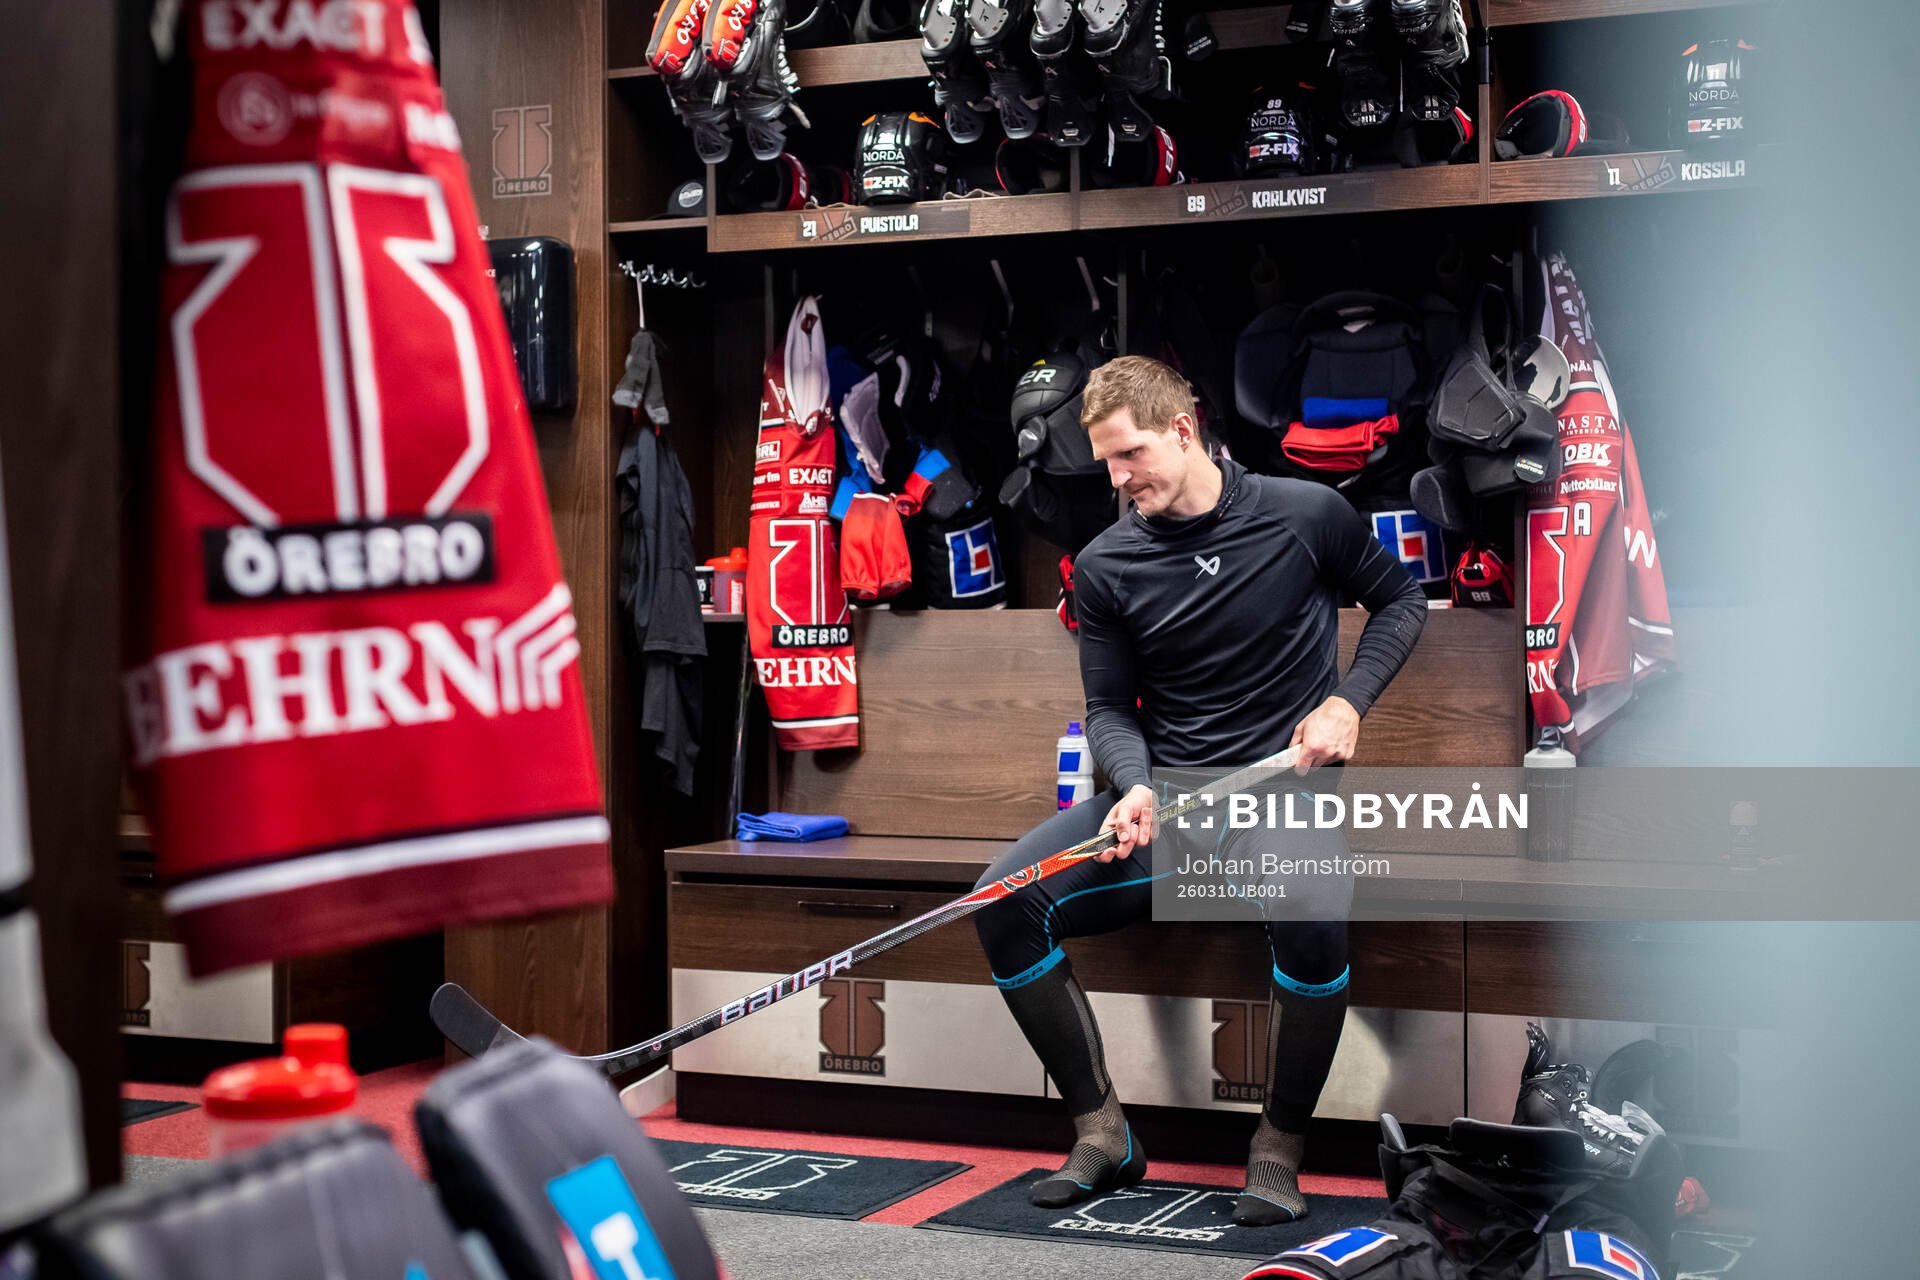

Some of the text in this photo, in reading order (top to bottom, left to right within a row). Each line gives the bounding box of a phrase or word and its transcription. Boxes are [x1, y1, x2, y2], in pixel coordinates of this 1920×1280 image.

[202, 0, 388, 57] EXACT
[1267, 99, 1282, 109] 89
[1681, 159, 1746, 181] KOSSILA
[497, 179, 548, 194] ÖREBRO
[1187, 195, 1206, 212] 89
[1251, 187, 1327, 209] KARLKVIST
[802, 220, 817, 237] 21
[860, 214, 919, 234] PUISTOLA
[1557, 415, 1618, 433] NASTA
[1564, 442, 1611, 462] OBK
[788, 468, 833, 485] EXACT
[222, 521, 486, 597] ÖREBRO
[777, 625, 850, 646] ÖREBRO
[720, 950, 853, 1026] BAUER
[823, 1056, 882, 1073] ÖREBRO
